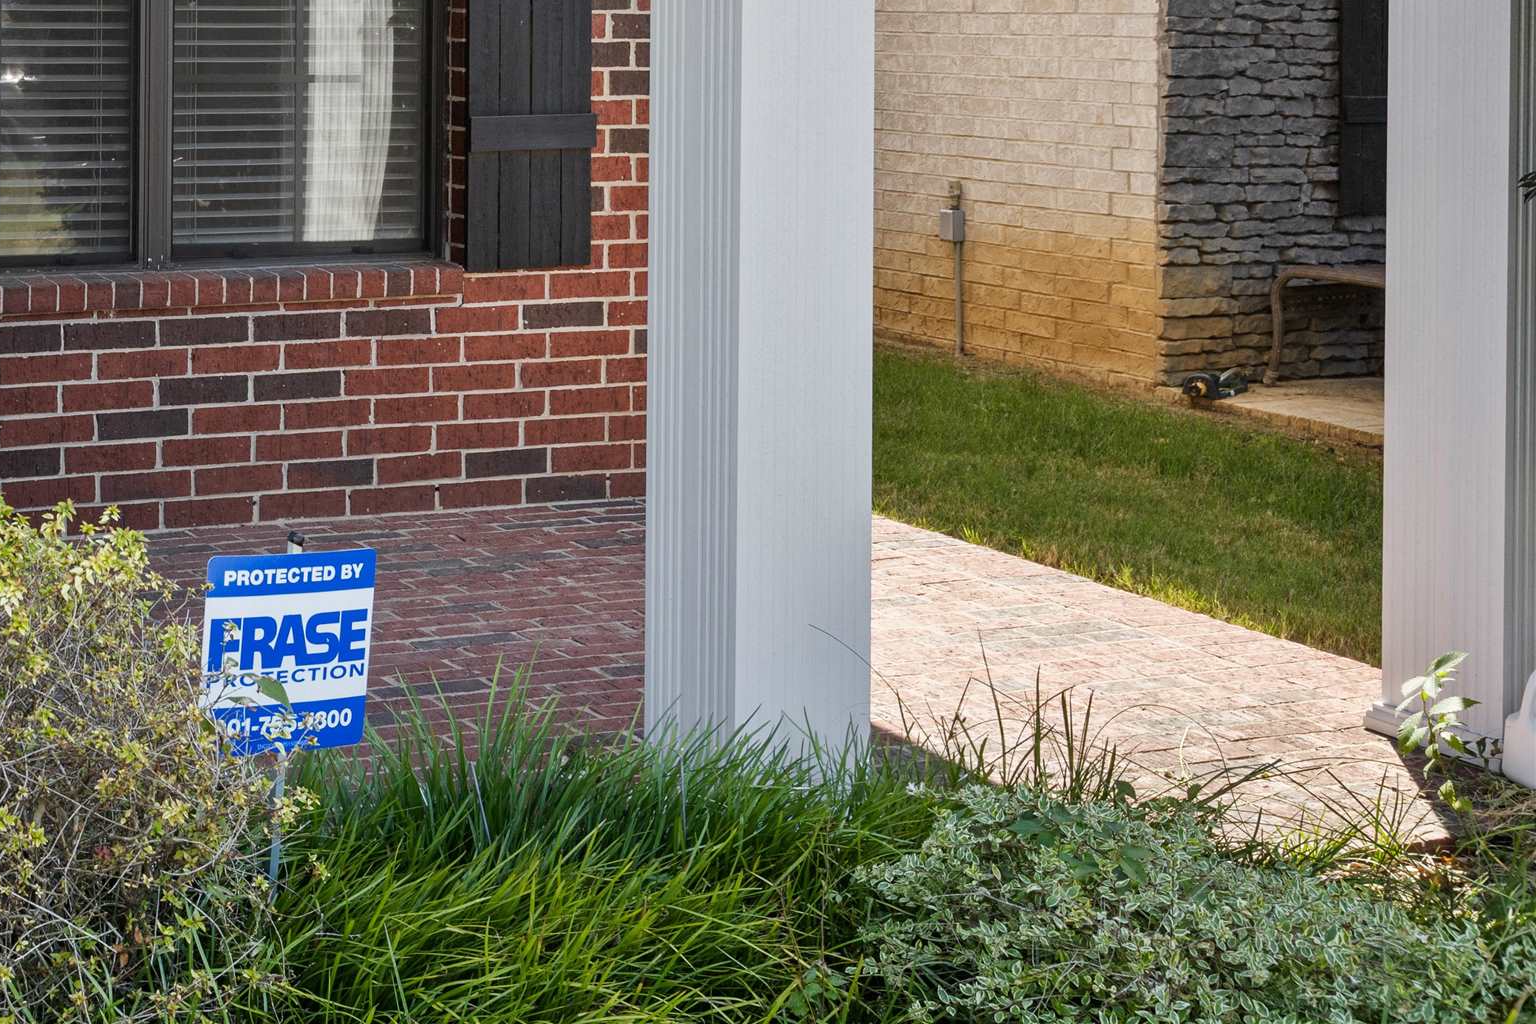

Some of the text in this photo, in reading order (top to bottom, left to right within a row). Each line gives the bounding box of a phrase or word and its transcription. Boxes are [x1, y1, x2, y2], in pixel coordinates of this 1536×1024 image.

[224, 563, 364, 586] PROTECTED BY
[207, 608, 369, 673] FRASE
